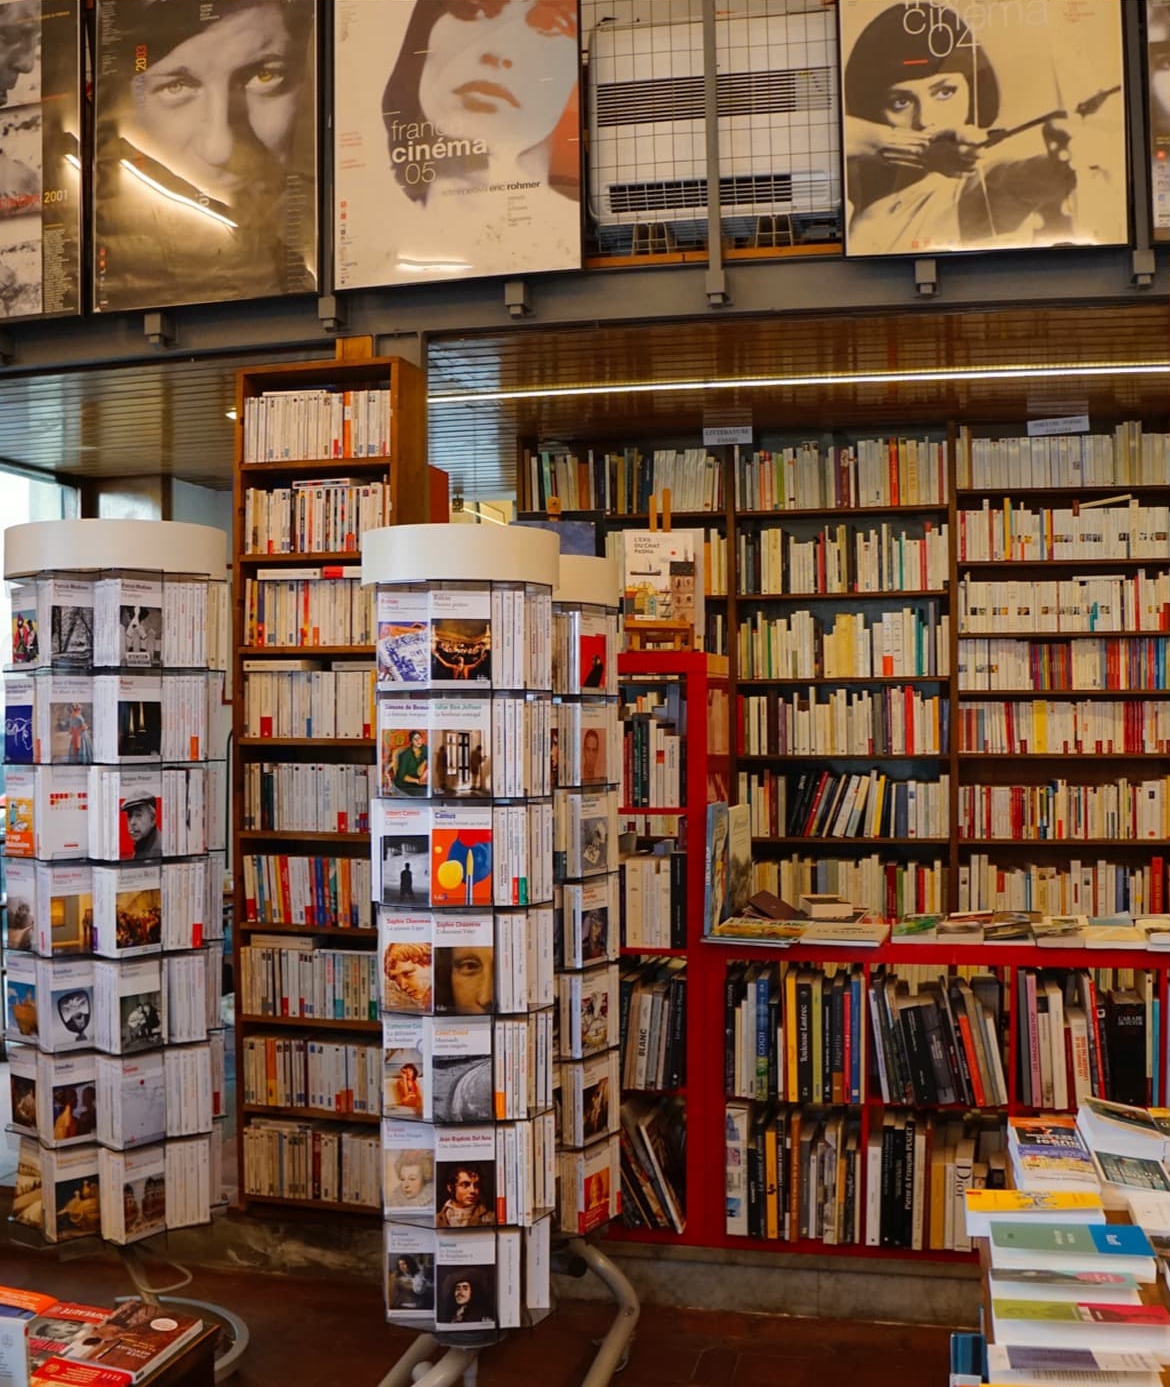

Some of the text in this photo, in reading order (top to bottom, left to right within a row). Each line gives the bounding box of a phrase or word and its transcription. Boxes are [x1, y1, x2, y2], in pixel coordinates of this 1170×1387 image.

[392, 138, 488, 163] cinéma
[405, 161, 436, 184] 05
[507, 181, 541, 191] rohmer
[44, 189, 70, 204] 2001
